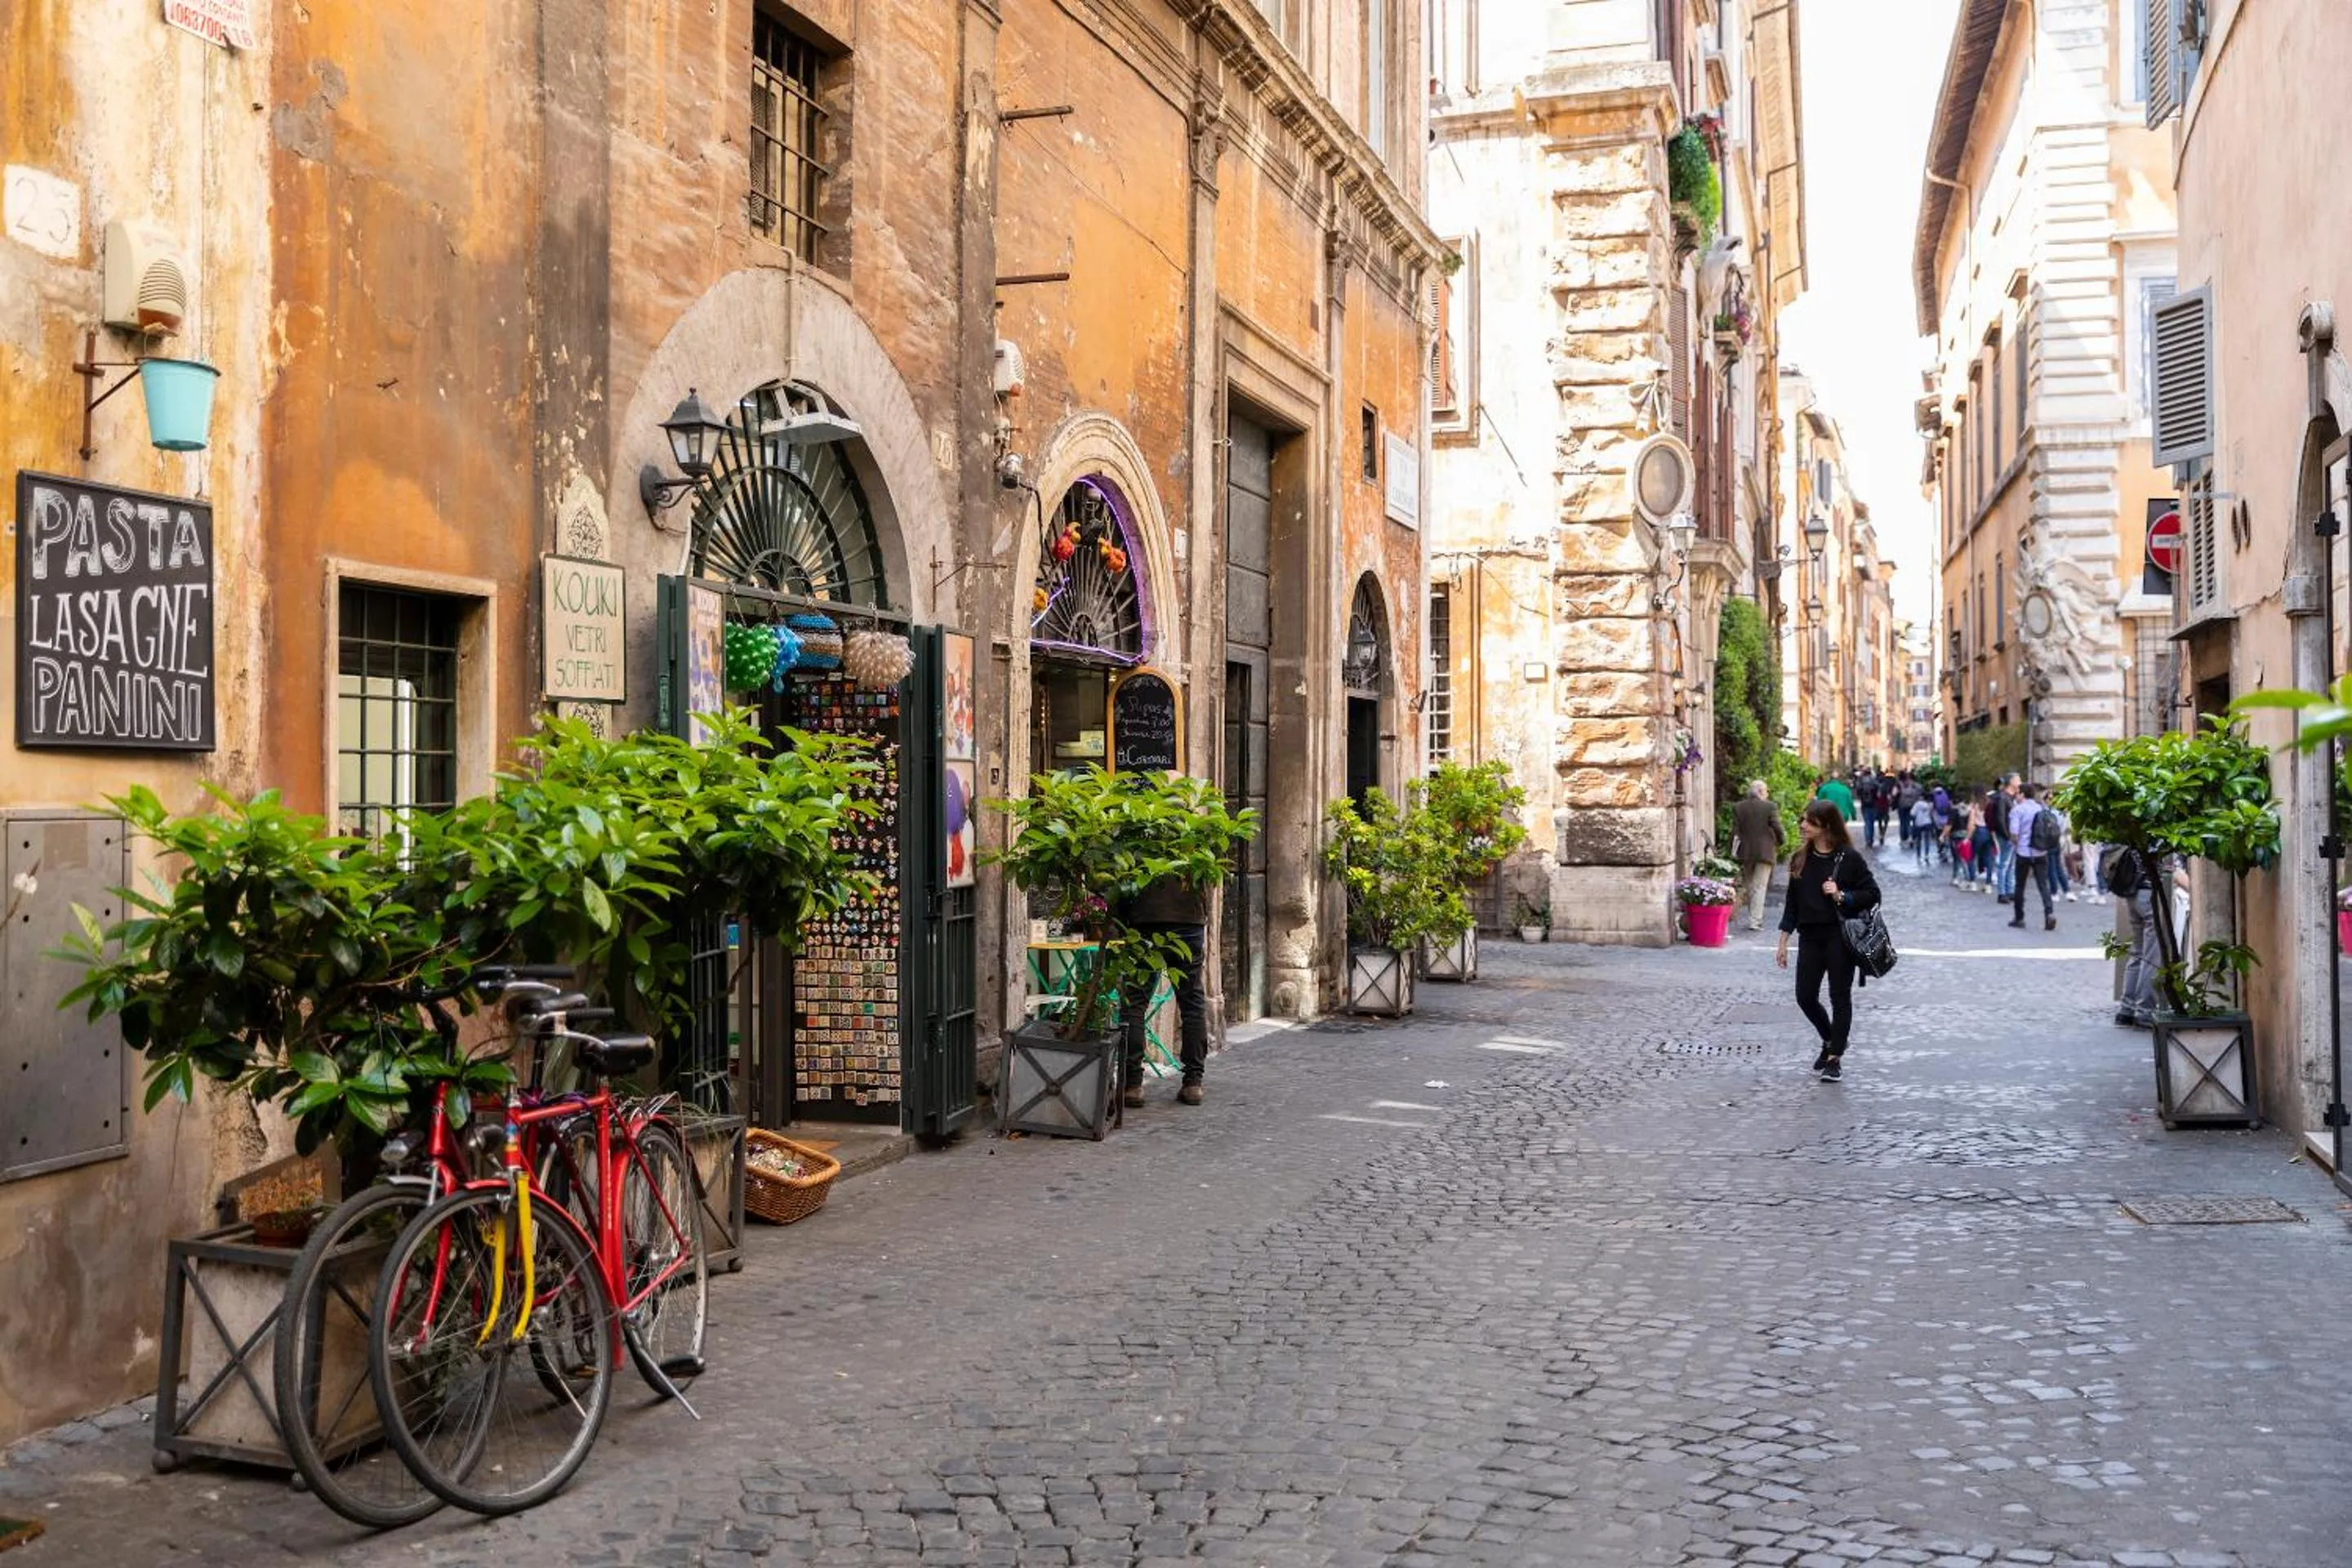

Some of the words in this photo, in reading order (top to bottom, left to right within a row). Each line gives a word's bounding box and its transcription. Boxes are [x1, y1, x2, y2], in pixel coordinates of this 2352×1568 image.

[32, 487, 205, 579] PASTA
[29, 583, 208, 678] LASAGNE
[552, 568, 617, 618] KOUKI
[565, 623, 608, 653] VETRI
[32, 657, 202, 742] PANINI
